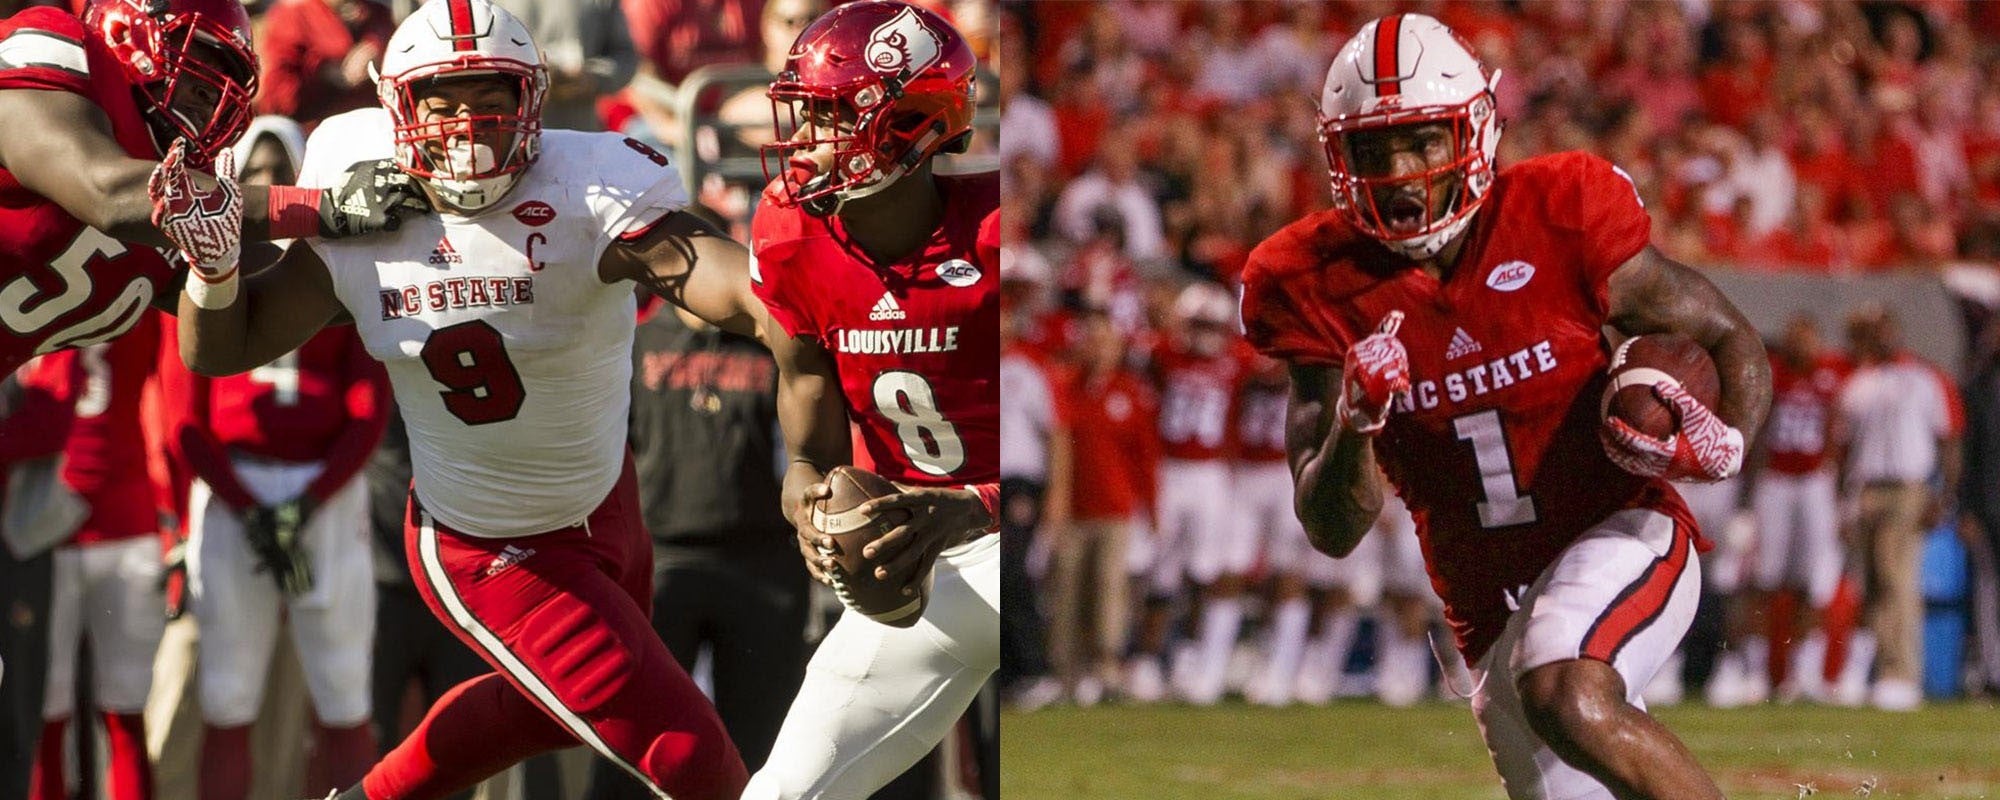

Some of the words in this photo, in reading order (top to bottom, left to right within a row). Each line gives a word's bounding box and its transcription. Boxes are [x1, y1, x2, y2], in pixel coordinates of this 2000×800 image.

[518, 206, 550, 218] ACC
[429, 254, 463, 265] adidas
[526, 232, 547, 272] C
[943, 266, 974, 278] ACC
[0, 224, 154, 356] 50
[1493, 265, 1527, 286] ACC
[379, 284, 422, 321] NC
[427, 276, 535, 312] STATE
[868, 308, 906, 321] adidas
[838, 326, 960, 354] LOUISVILLE
[420, 318, 527, 425] 9
[1444, 339, 1558, 403] STATE
[872, 370, 966, 477] 8
[1452, 408, 1538, 529] 1
